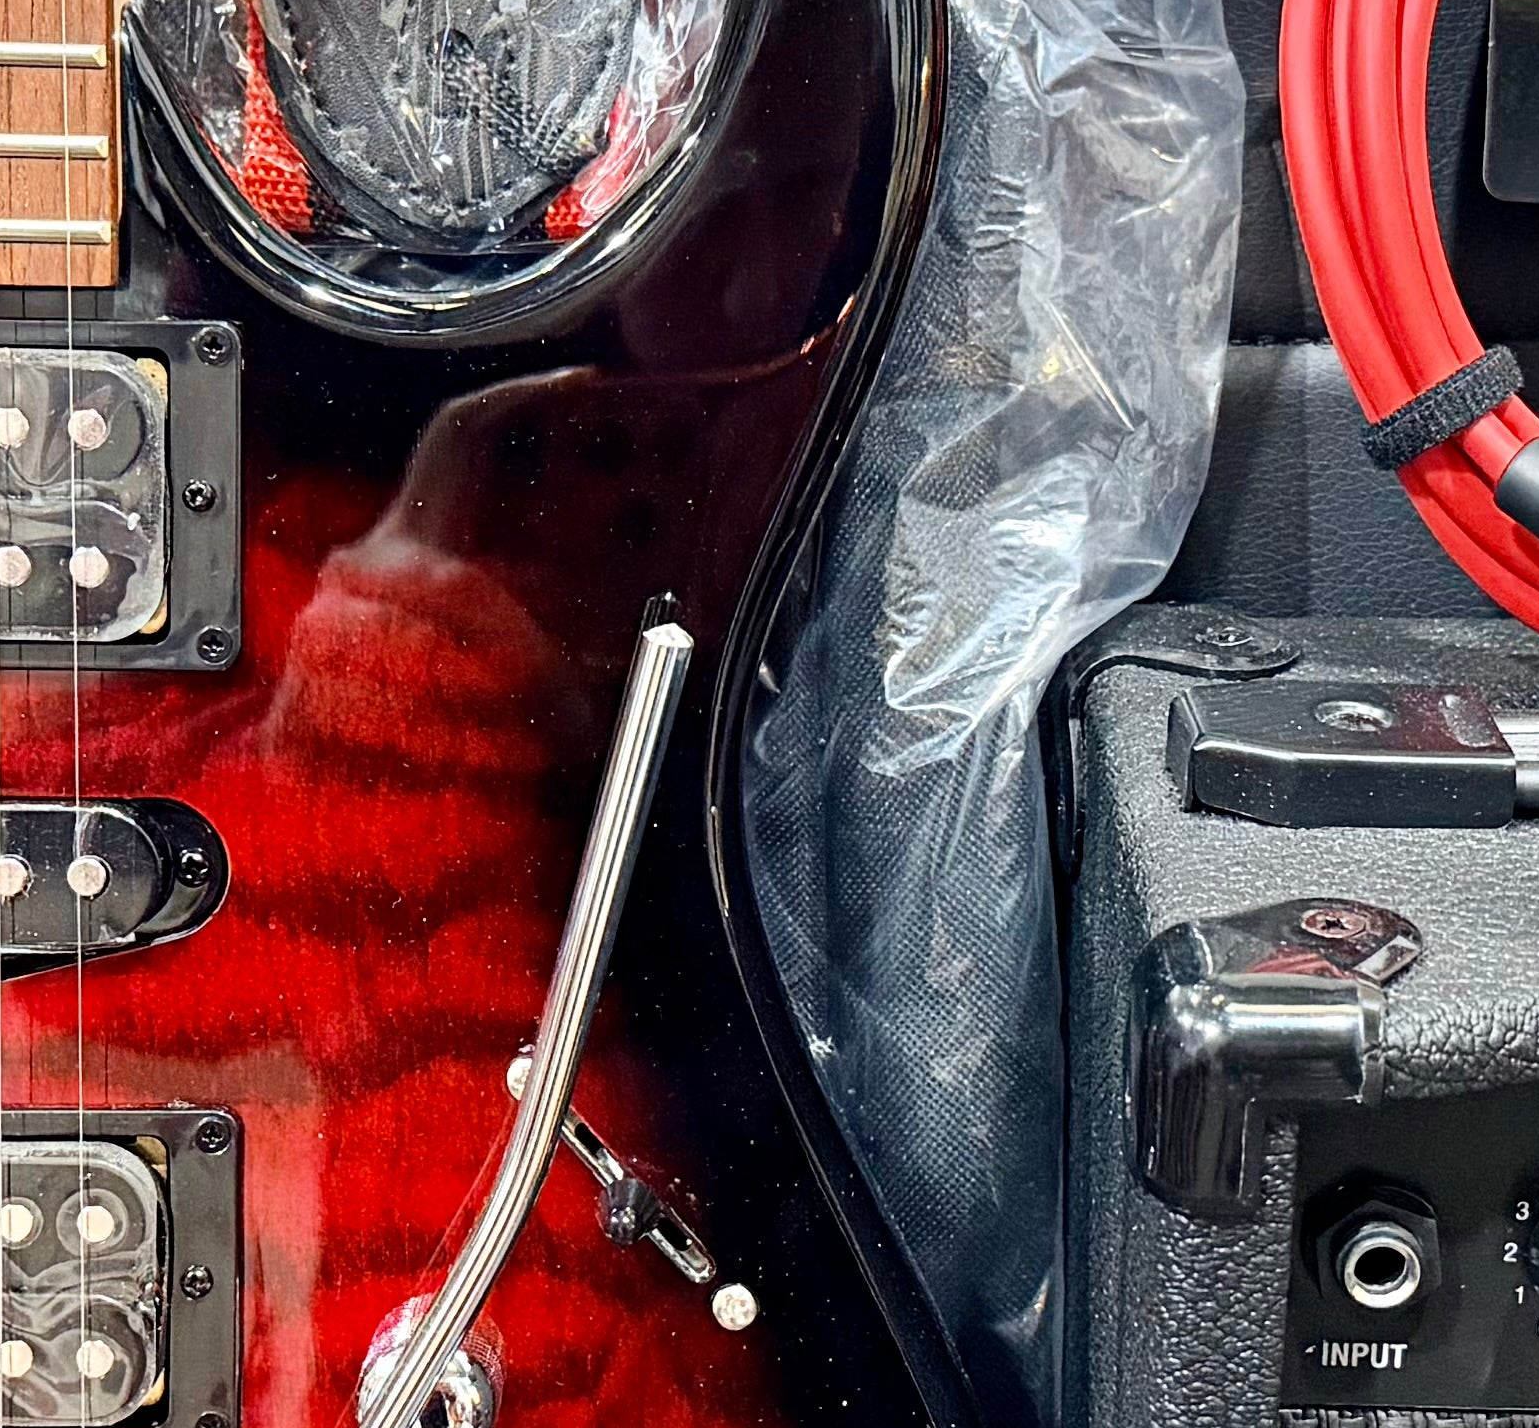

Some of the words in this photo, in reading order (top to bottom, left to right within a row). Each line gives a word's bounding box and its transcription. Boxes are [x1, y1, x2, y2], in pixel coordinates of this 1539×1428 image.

[1515, 1201, 1530, 1221] 3
[1503, 1243, 1518, 1263] 2
[1515, 1285, 1525, 1305] 1
[1322, 1340, 1408, 1369] INPUT
